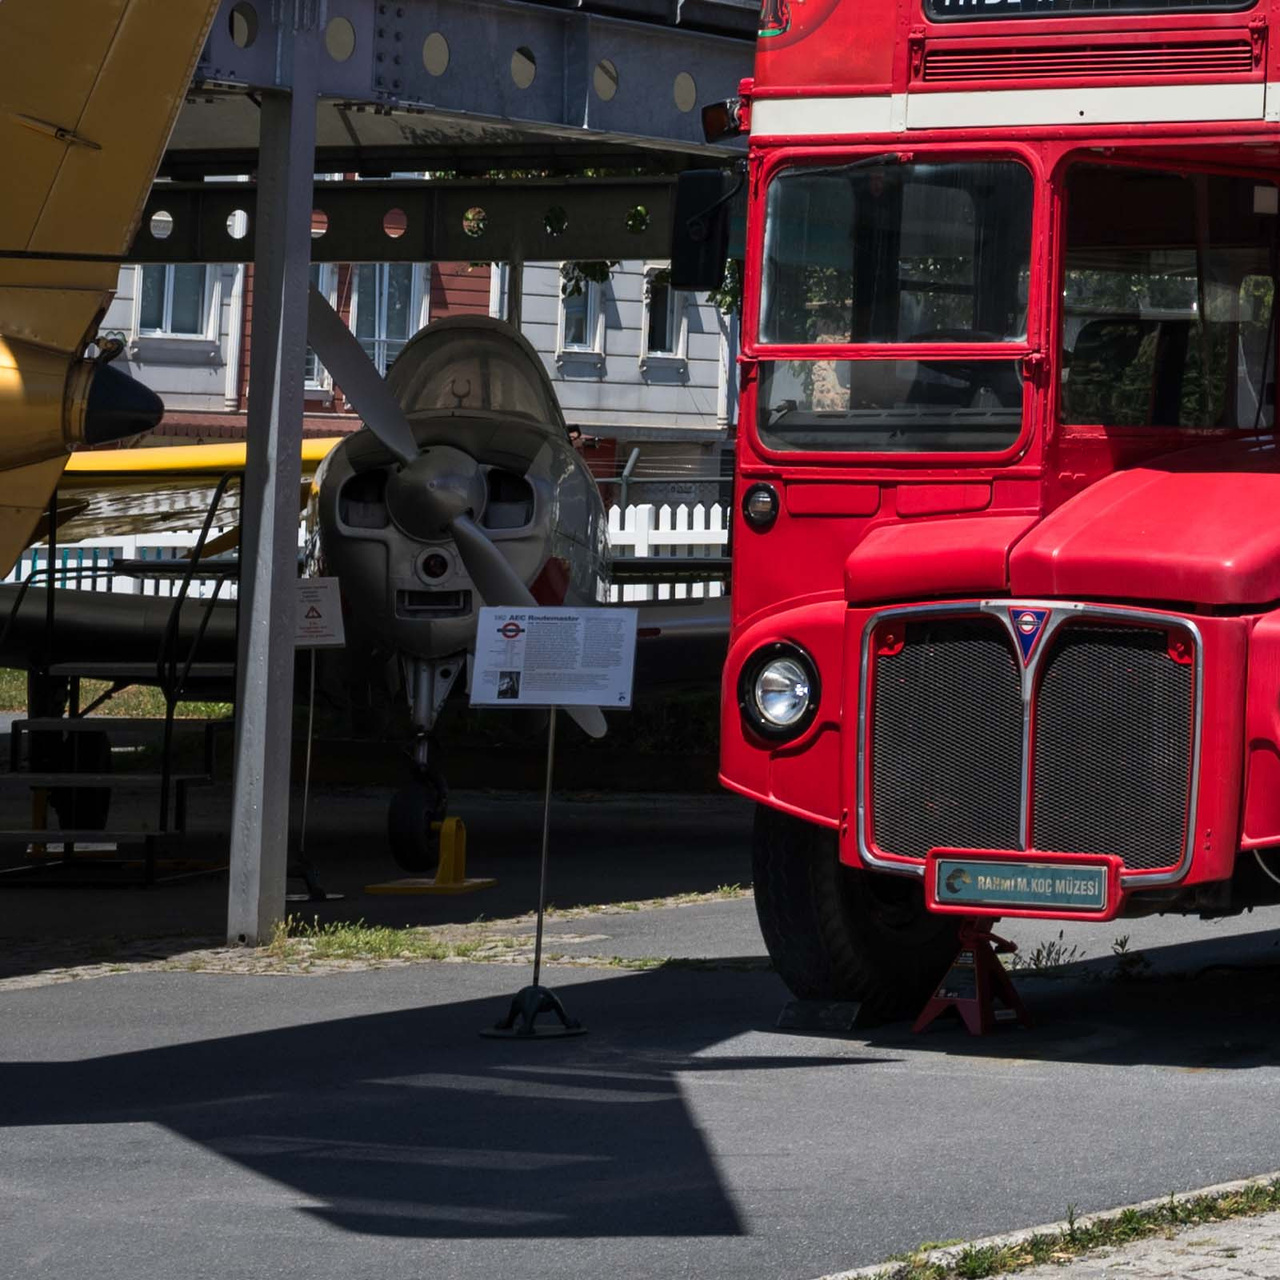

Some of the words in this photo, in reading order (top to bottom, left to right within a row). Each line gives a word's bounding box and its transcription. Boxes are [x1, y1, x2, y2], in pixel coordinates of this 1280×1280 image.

[528, 614, 580, 622] Routemaster
[1031, 879, 1052, 897] KOÇ
[1055, 876, 1099, 897] MÜZESİ
